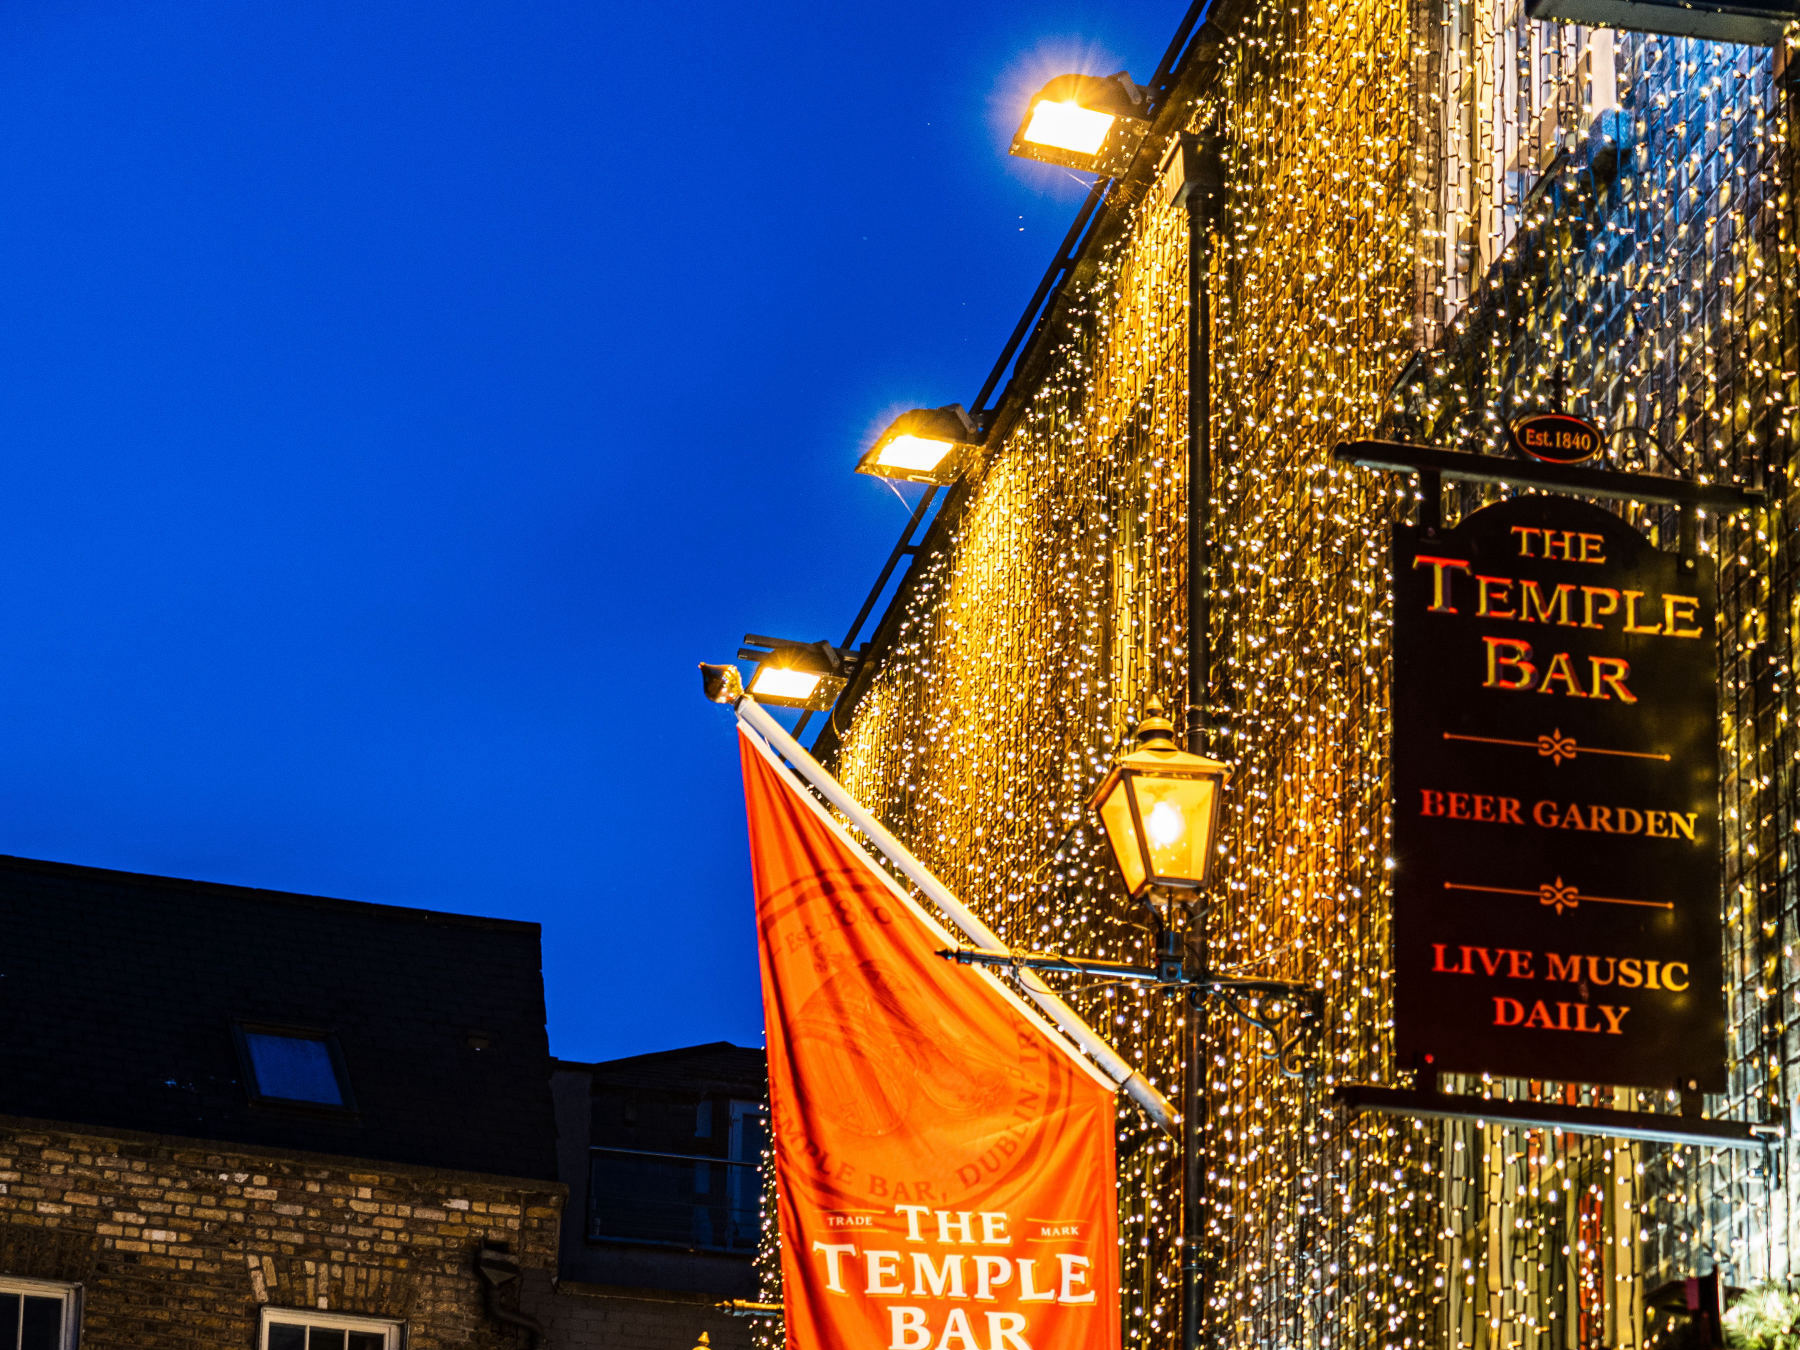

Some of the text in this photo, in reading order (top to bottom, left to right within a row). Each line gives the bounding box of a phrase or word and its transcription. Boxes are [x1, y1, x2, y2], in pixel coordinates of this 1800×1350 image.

[1510, 525, 1607, 565] THE
[1412, 554, 1703, 639] TEMPLE
[1481, 635, 1638, 703] BAR
[1419, 788, 1699, 841] BEER GARDEN
[1431, 943, 1691, 992] LIVE MUSIC
[1492, 996, 1631, 1036] DAILY
[828, 1203, 1080, 1246] TRADE THE MARK
[812, 1240, 1097, 1306] TEMPLE
